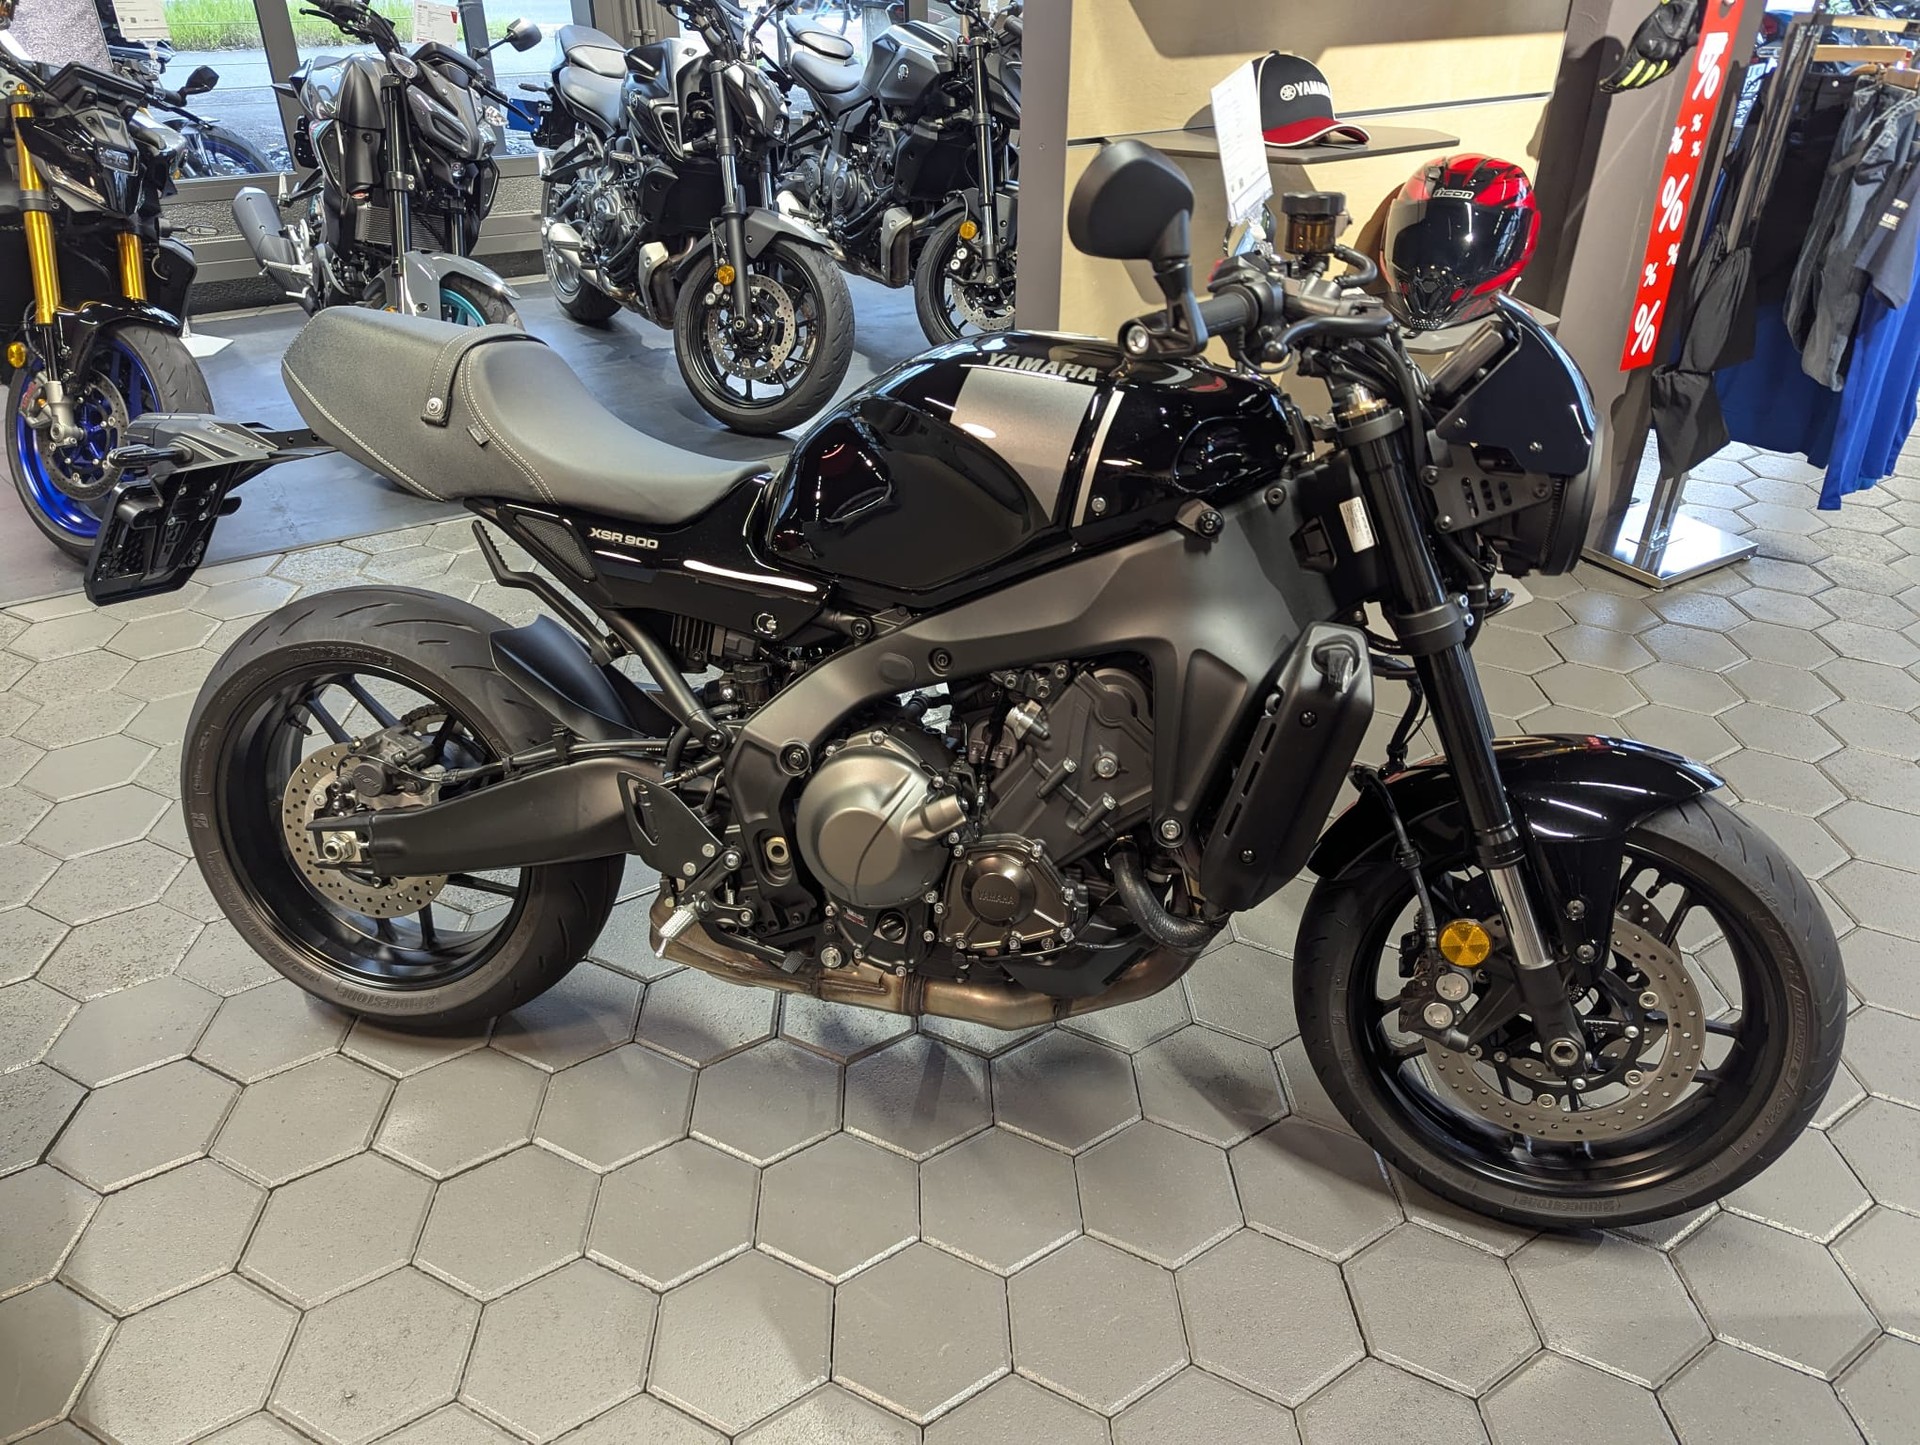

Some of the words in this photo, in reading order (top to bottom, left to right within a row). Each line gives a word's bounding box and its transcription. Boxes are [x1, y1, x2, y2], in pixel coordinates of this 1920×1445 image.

[1294, 80, 1331, 99] YAMA
[1658, 173, 1690, 233] %
[1643, 262, 1659, 287] %
[1630, 300, 1661, 356] %
[987, 352, 1098, 382] YAMAHA
[589, 527, 623, 543] XSR
[624, 534, 659, 549] 900
